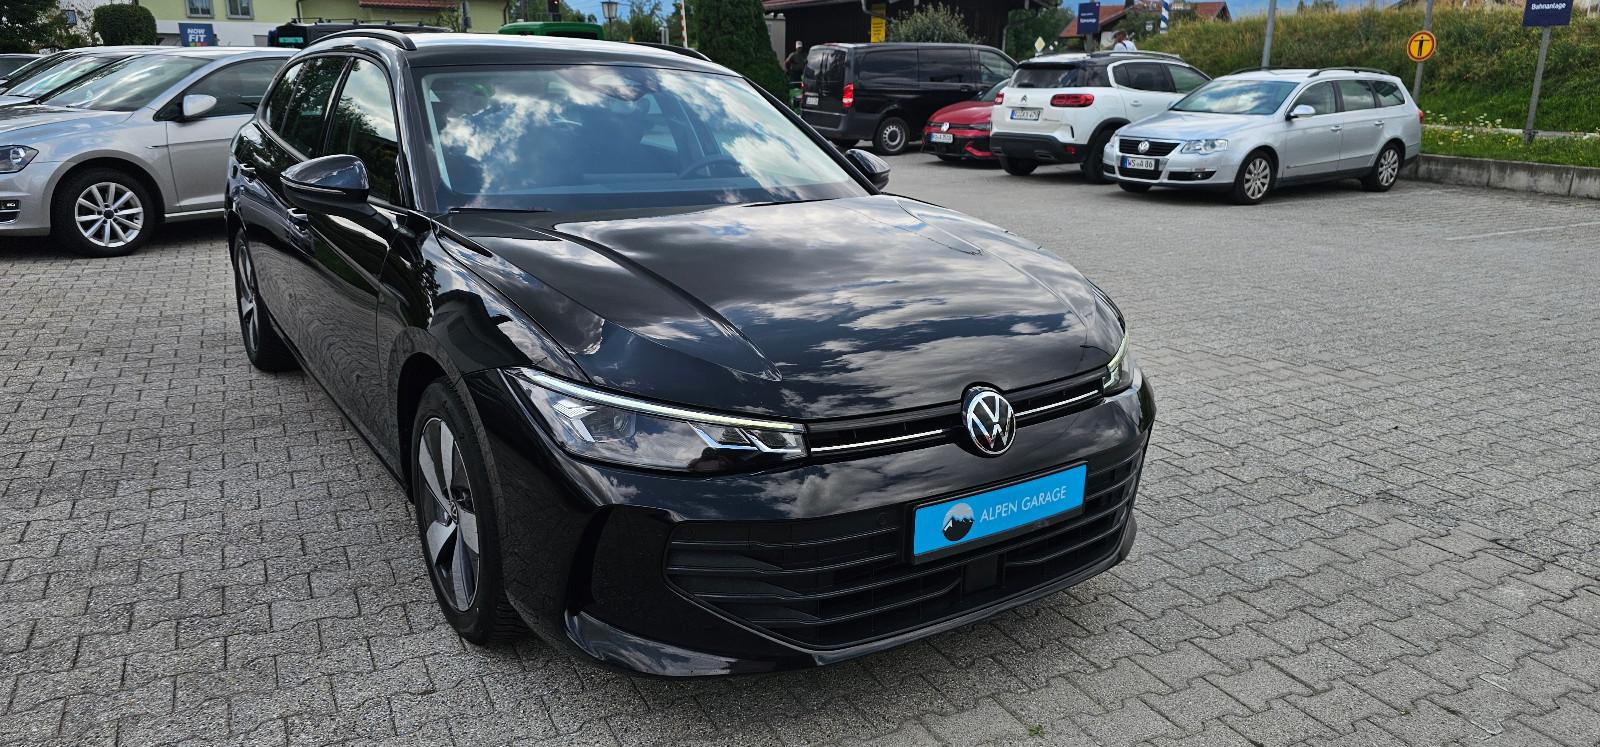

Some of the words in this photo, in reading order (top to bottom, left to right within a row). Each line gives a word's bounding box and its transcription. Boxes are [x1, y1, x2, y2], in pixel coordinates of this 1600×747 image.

[189, 34, 206, 42] FIT
[980, 500, 1018, 522] ALPEN
[1021, 485, 1067, 511] GARAGE
